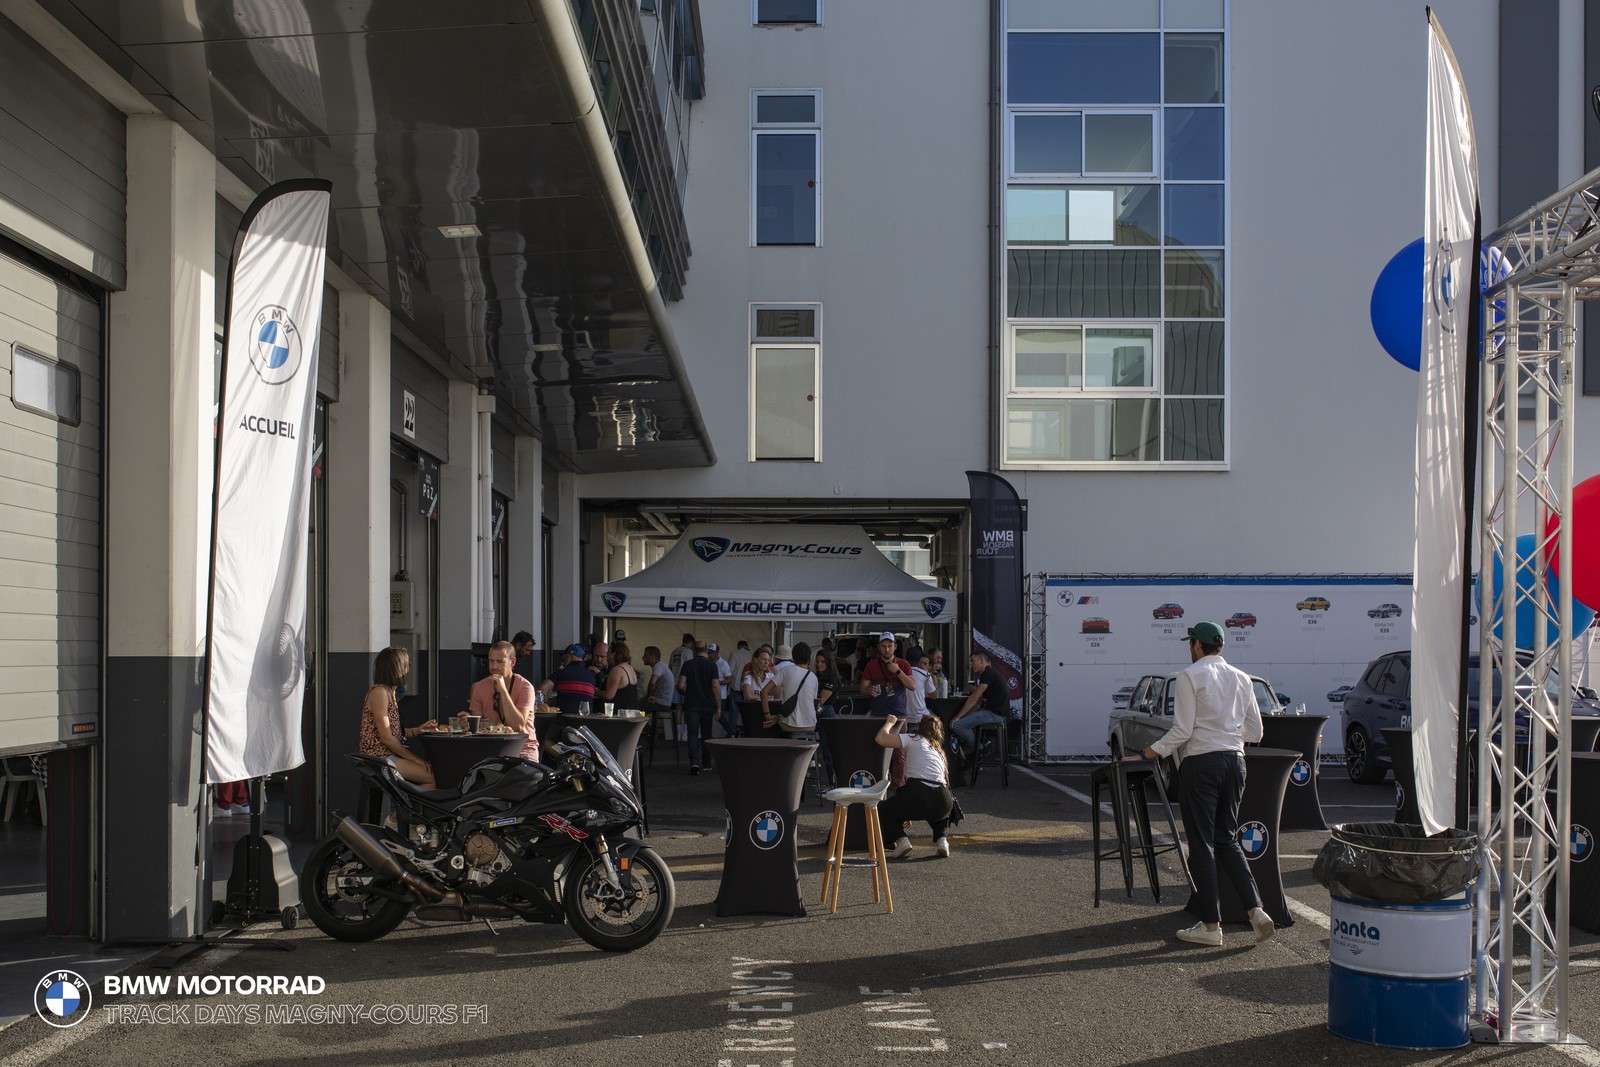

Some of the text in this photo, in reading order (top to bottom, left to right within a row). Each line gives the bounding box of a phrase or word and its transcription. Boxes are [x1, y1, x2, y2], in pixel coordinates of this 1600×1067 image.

[258, 309, 294, 334] BMW
[239, 414, 295, 440] ACCUEIL
[729, 542, 863, 555] Magny-Cours
